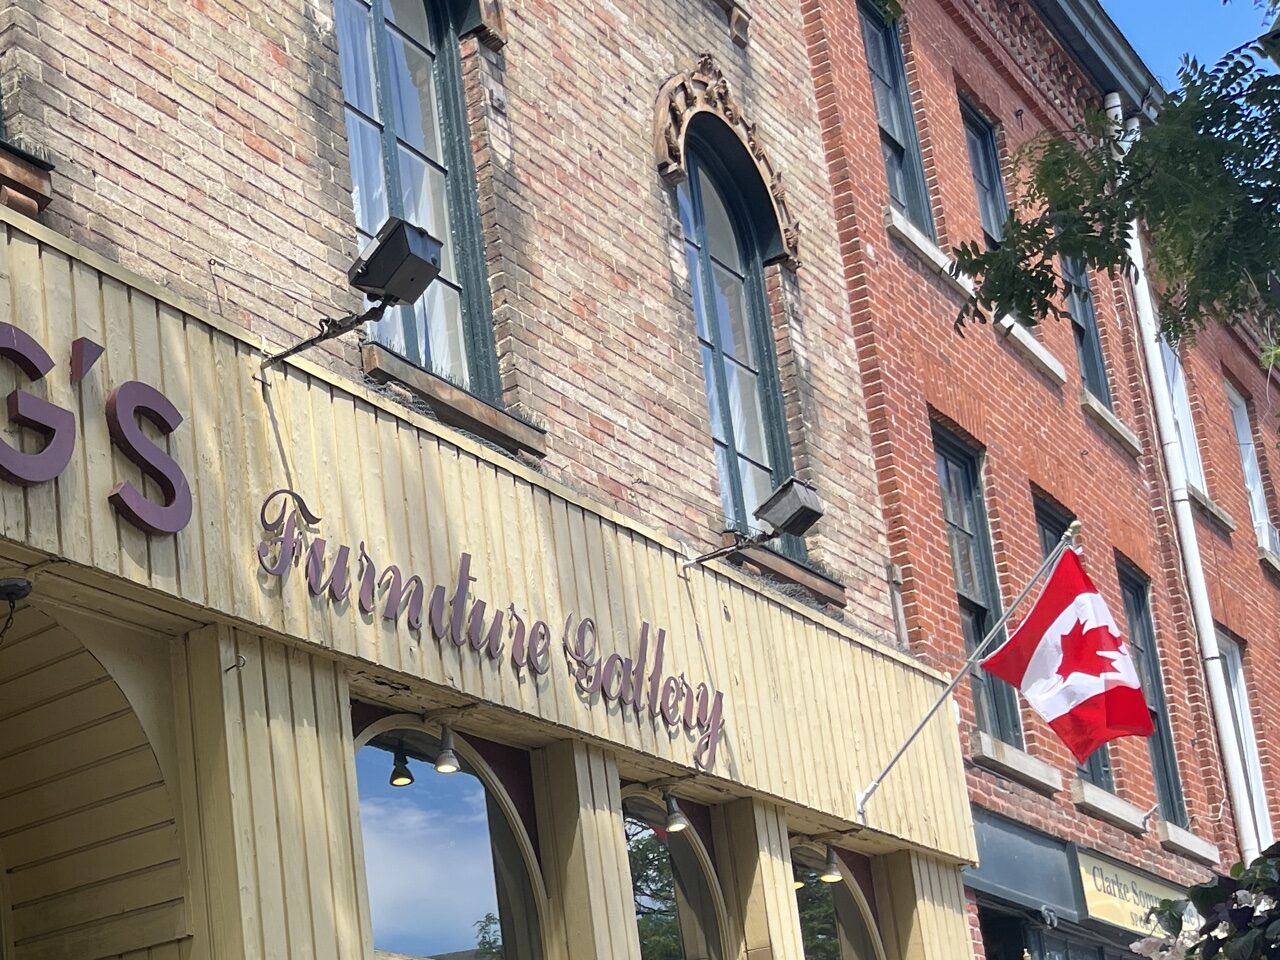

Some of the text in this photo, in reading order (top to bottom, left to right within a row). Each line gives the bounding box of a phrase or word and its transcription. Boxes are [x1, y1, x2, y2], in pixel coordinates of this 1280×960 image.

[257, 488, 726, 773] Furniture Gallery
[1092, 866, 1131, 902] Clarke
